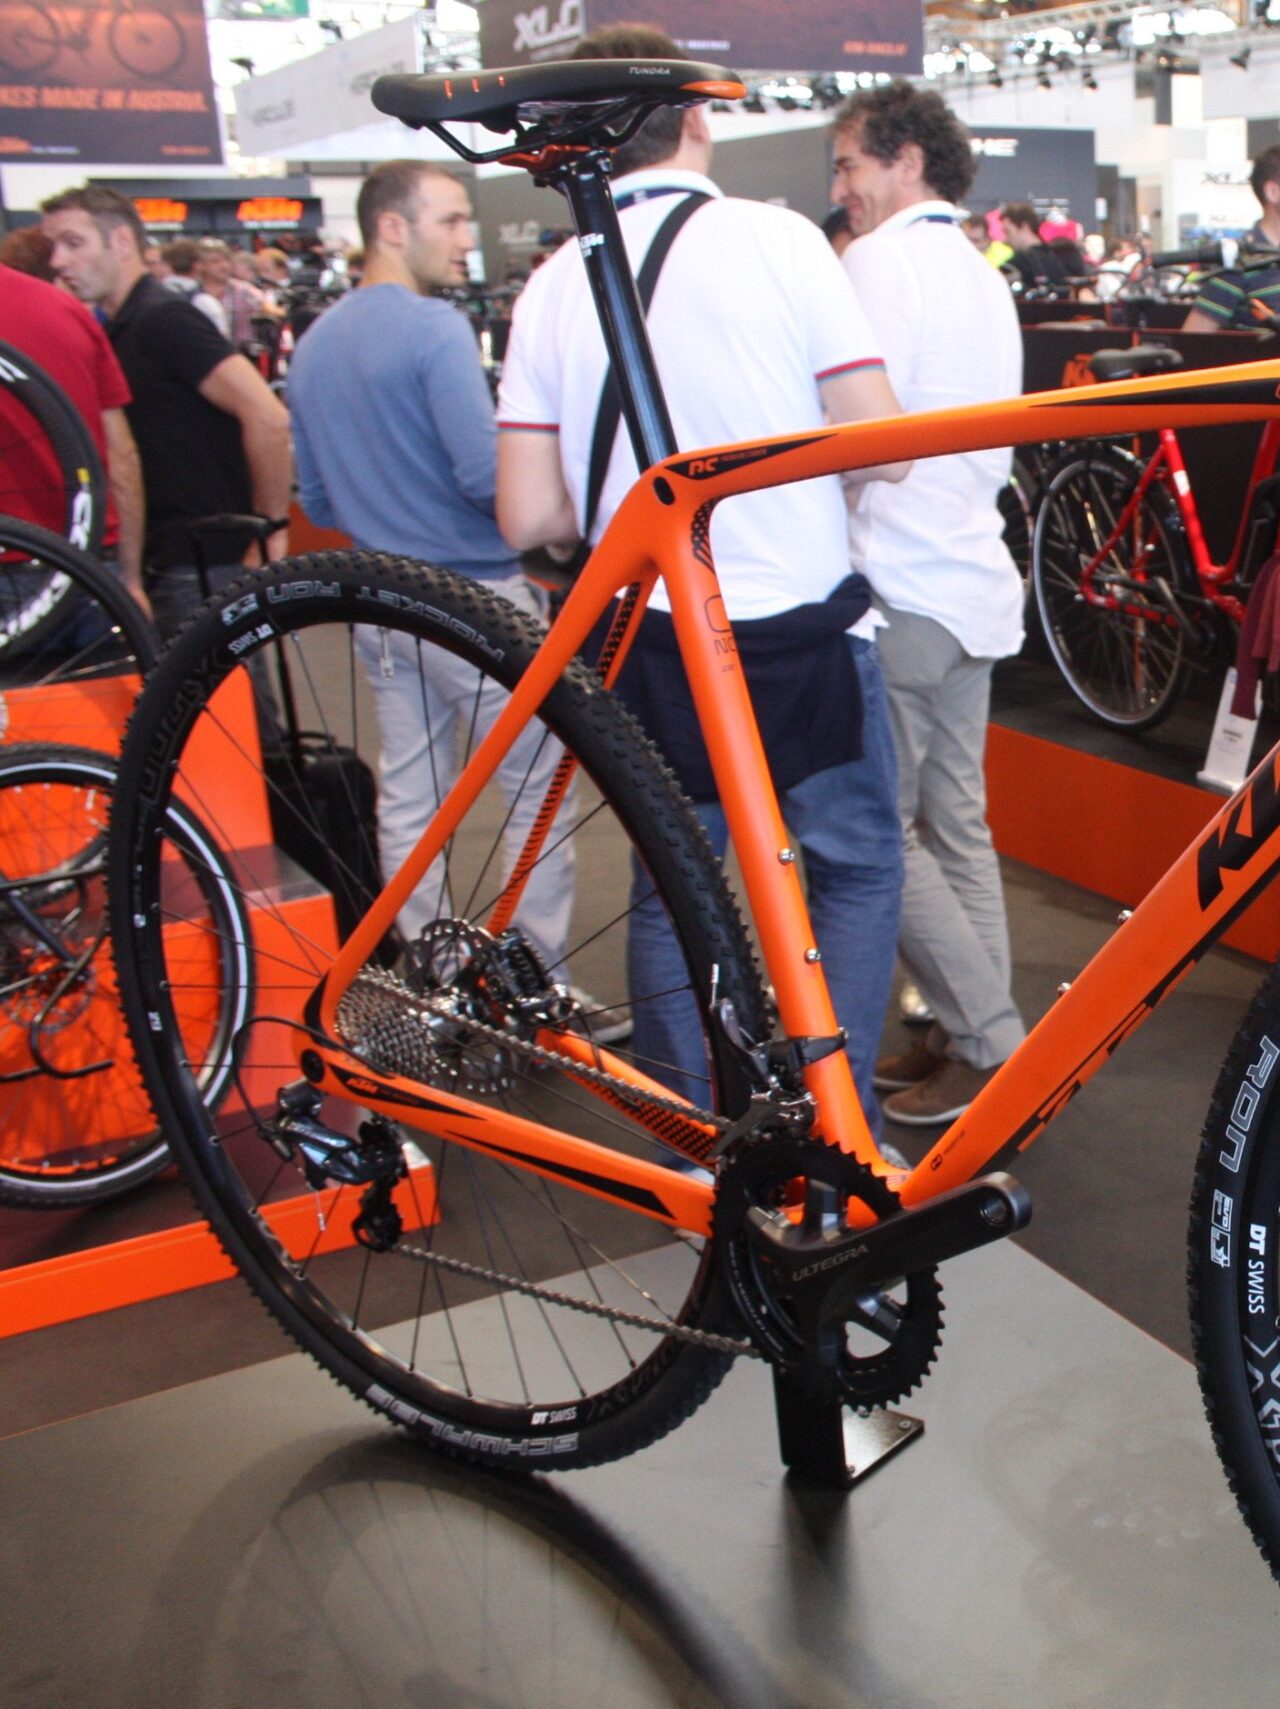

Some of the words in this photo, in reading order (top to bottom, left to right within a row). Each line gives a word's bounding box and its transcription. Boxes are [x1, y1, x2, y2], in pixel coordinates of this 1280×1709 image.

[629, 66, 671, 75] TUNDRA
[355, 585, 506, 662] ROCKET
[1218, 1035, 1280, 1173] RON
[1249, 1223, 1266, 1256] DT
[791, 1244, 869, 1282] ULTEGRA
[1247, 1259, 1265, 1315] SWISS
[549, 1406, 577, 1424] SWISS
